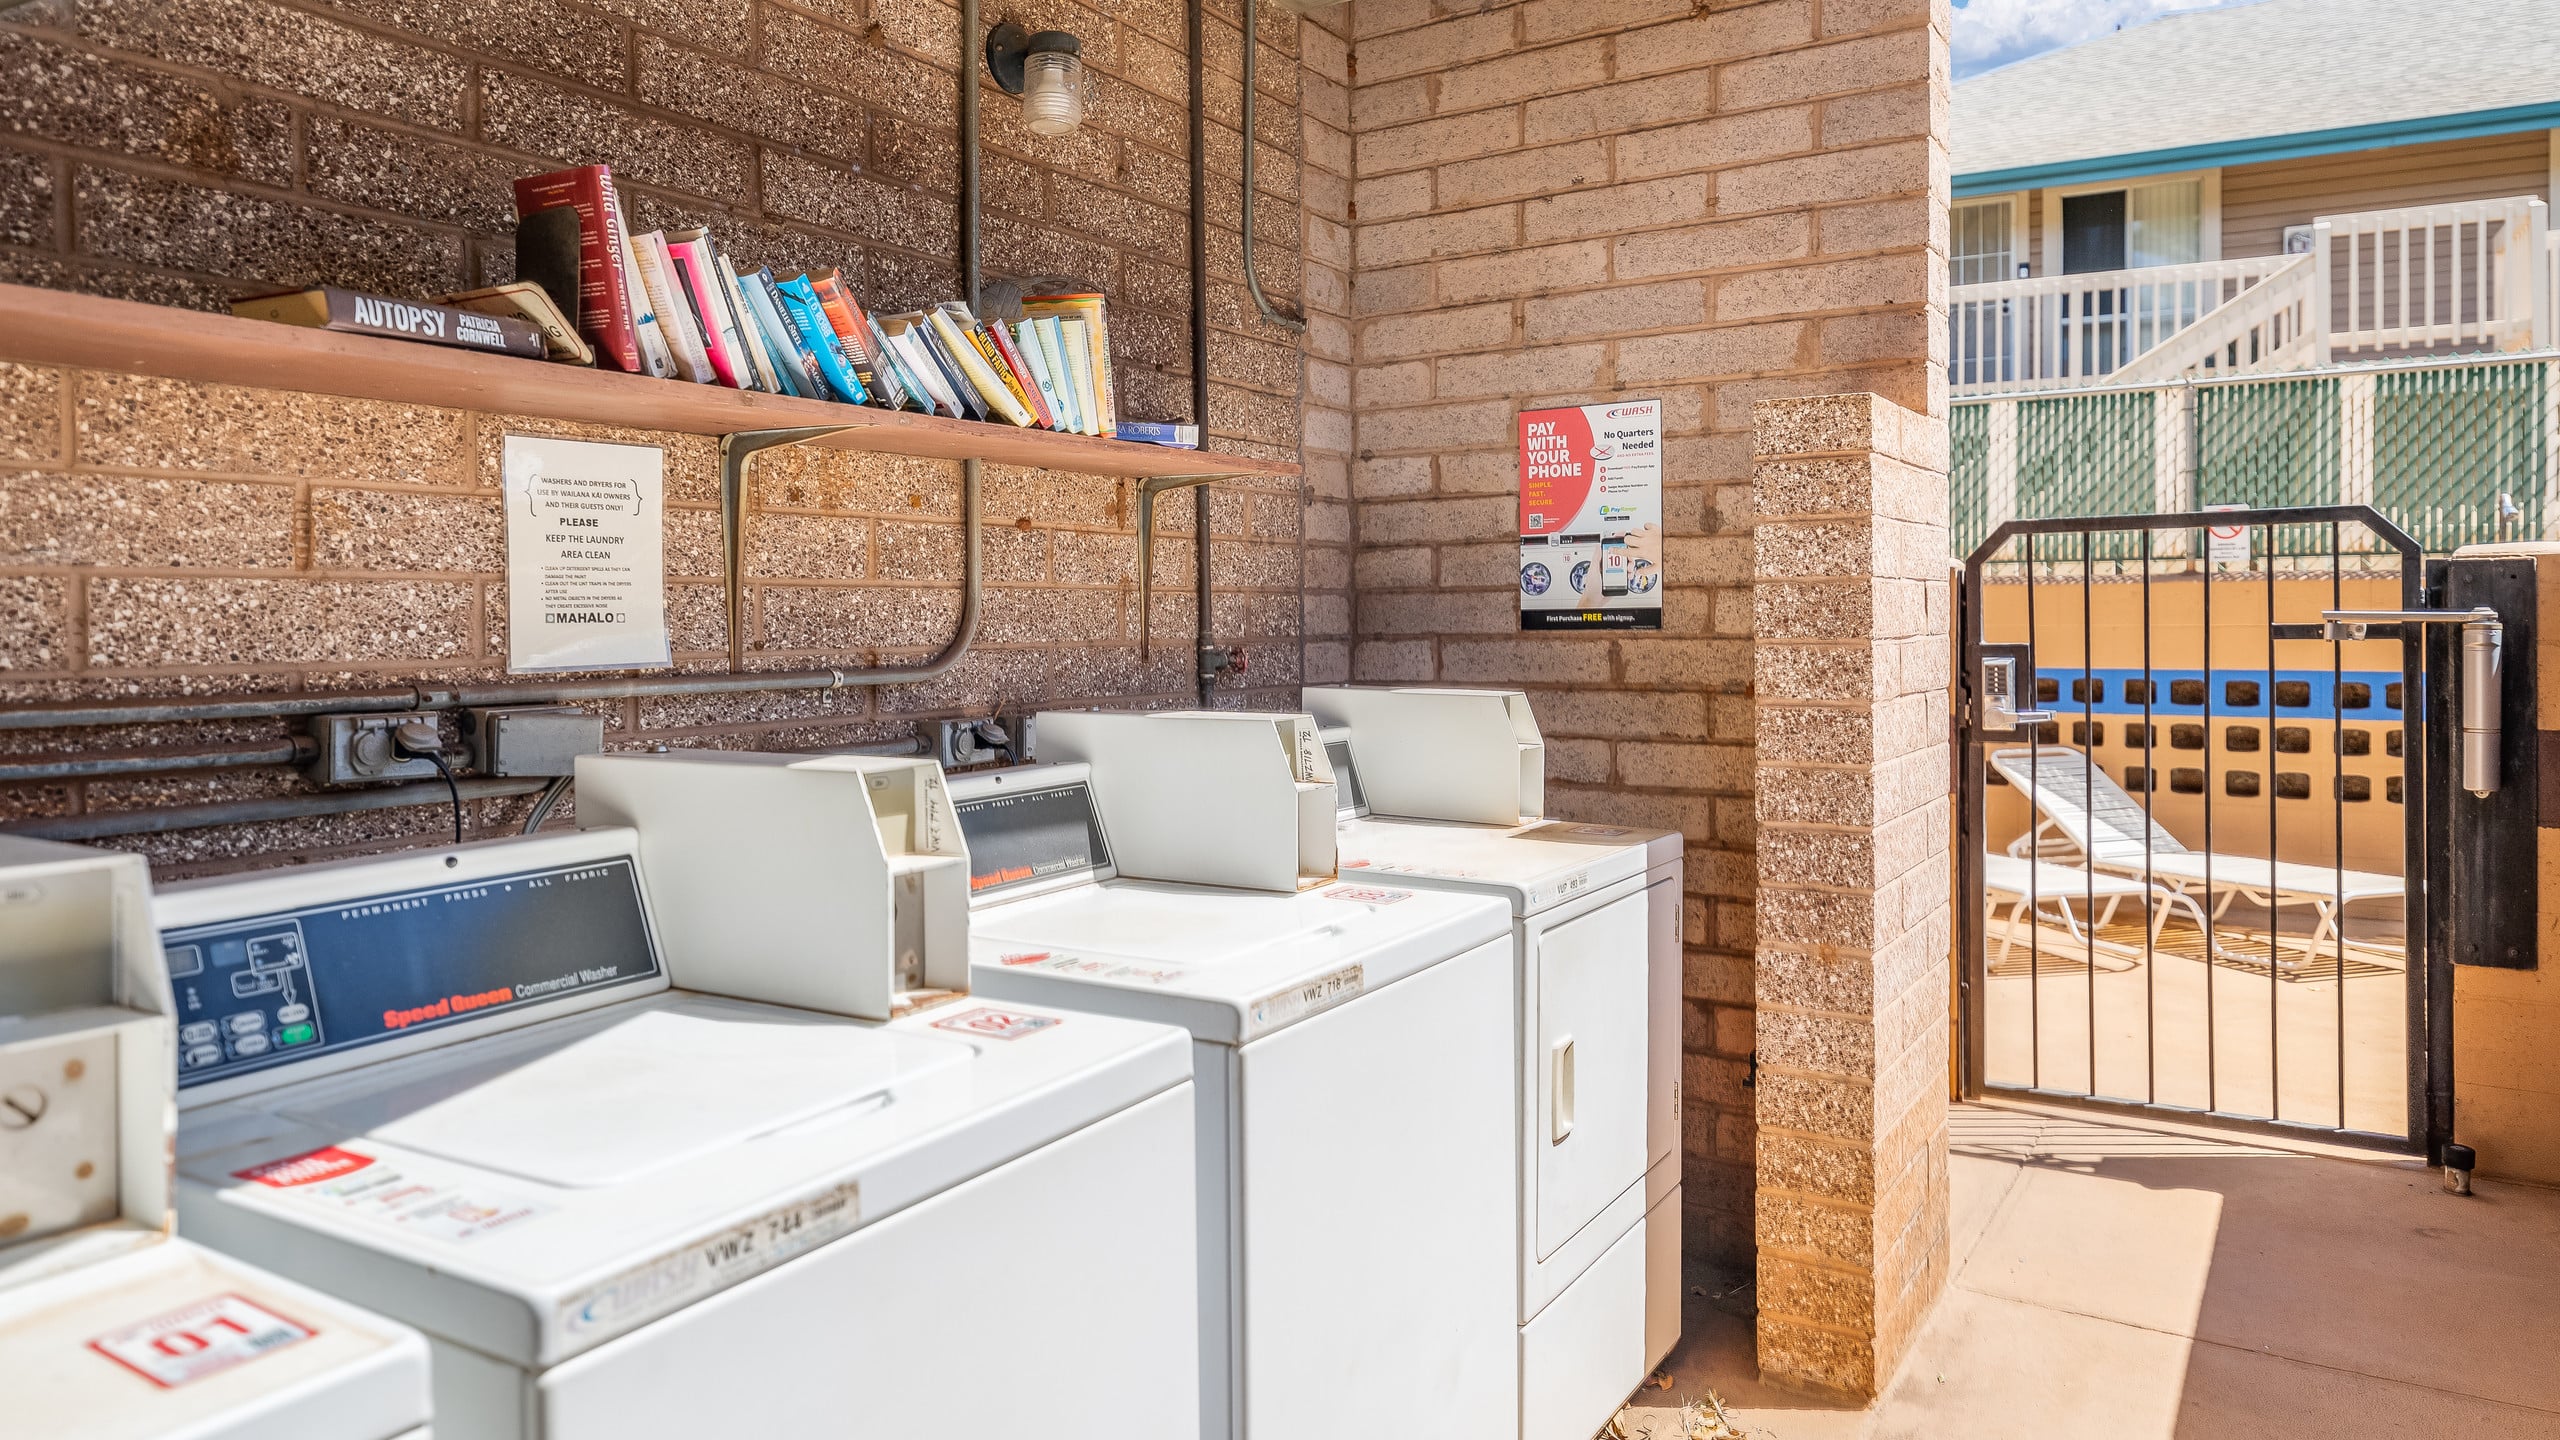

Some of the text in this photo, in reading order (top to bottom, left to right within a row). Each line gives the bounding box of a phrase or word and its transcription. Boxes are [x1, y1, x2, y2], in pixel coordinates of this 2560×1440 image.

[599, 174, 623, 271] Wild Ginger
[354, 296, 446, 338] AUTOPSY
[458, 313, 502, 333] PATRICIA
[771, 289, 802, 346] DANIELLE STEEL
[815, 310, 832, 338] ROBB
[456, 326, 507, 348] CORNWELL
[978, 332, 996, 358] BLIND
[991, 355, 1008, 380] FAITH
[809, 366, 829, 396] MAGIC
[1621, 405, 1653, 416] WASH
[1128, 424, 1161, 436] ROBERTS
[1527, 421, 1556, 437] PAY
[1603, 429, 1654, 440] No Quarters
[1527, 435, 1568, 451] WITH
[1622, 440, 1654, 450] Needed
[1527, 449, 1570, 465] YOUR
[1528, 463, 1582, 479] PHONE
[541, 477, 572, 486] WASHERS
[588, 480, 613, 489] DRYERS
[613, 481, 627, 489] FOR
[551, 489, 559, 497] BY
[560, 490, 591, 499] WAILANA
[603, 492, 631, 501] OWNERS
[580, 503, 605, 511] GUESTS
[605, 504, 624, 512] ONLY!
[559, 517, 599, 528] PLEASE
[545, 534, 625, 545] KEEP THE LAUNDRY
[560, 550, 611, 559] AREA CLEAN
[1608, 555, 1621, 567] 10
[556, 612, 615, 624] MAHALO
[1582, 613, 1603, 622] FREE
[956, 803, 985, 813] MANENT
[992, 799, 1014, 808] PRESS
[1051, 790, 1074, 799] FABRIC
[341, 868, 610, 921] PERMANENT PRESS ALL FABRIC
[383, 965, 619, 1029] Speed Queen Commercial Washer
[1302, 984, 1323, 1003] VWZ
[1327, 978, 1341, 995] 718
[704, 1231, 755, 1268] VWZ
[150, 1315, 252, 1357] 01
